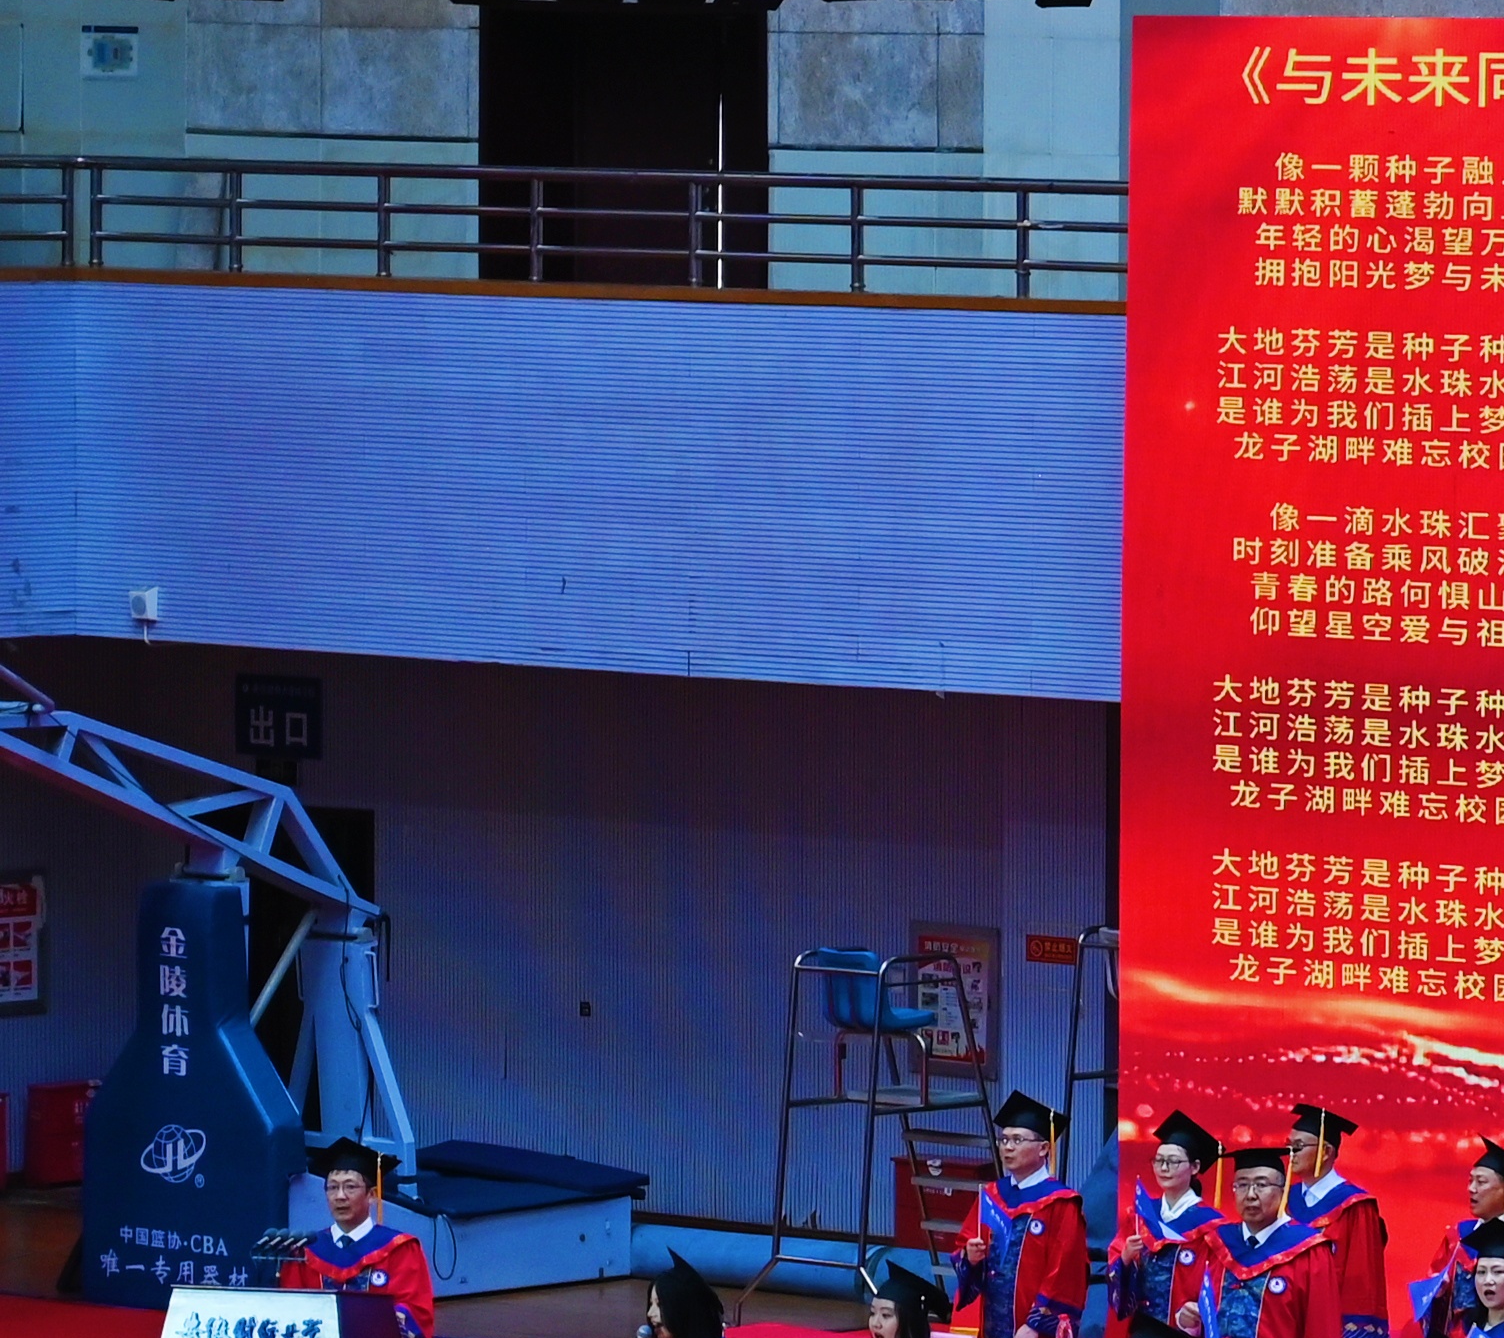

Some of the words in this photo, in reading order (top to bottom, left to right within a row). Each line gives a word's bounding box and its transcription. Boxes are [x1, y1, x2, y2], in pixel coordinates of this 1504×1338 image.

[250, 705, 308, 748] 出口
[0, 888, 28, 906] 火栓
[158, 926, 190, 1077] 金陵体育
[100, 1248, 249, 1287] 唯一专用器材
